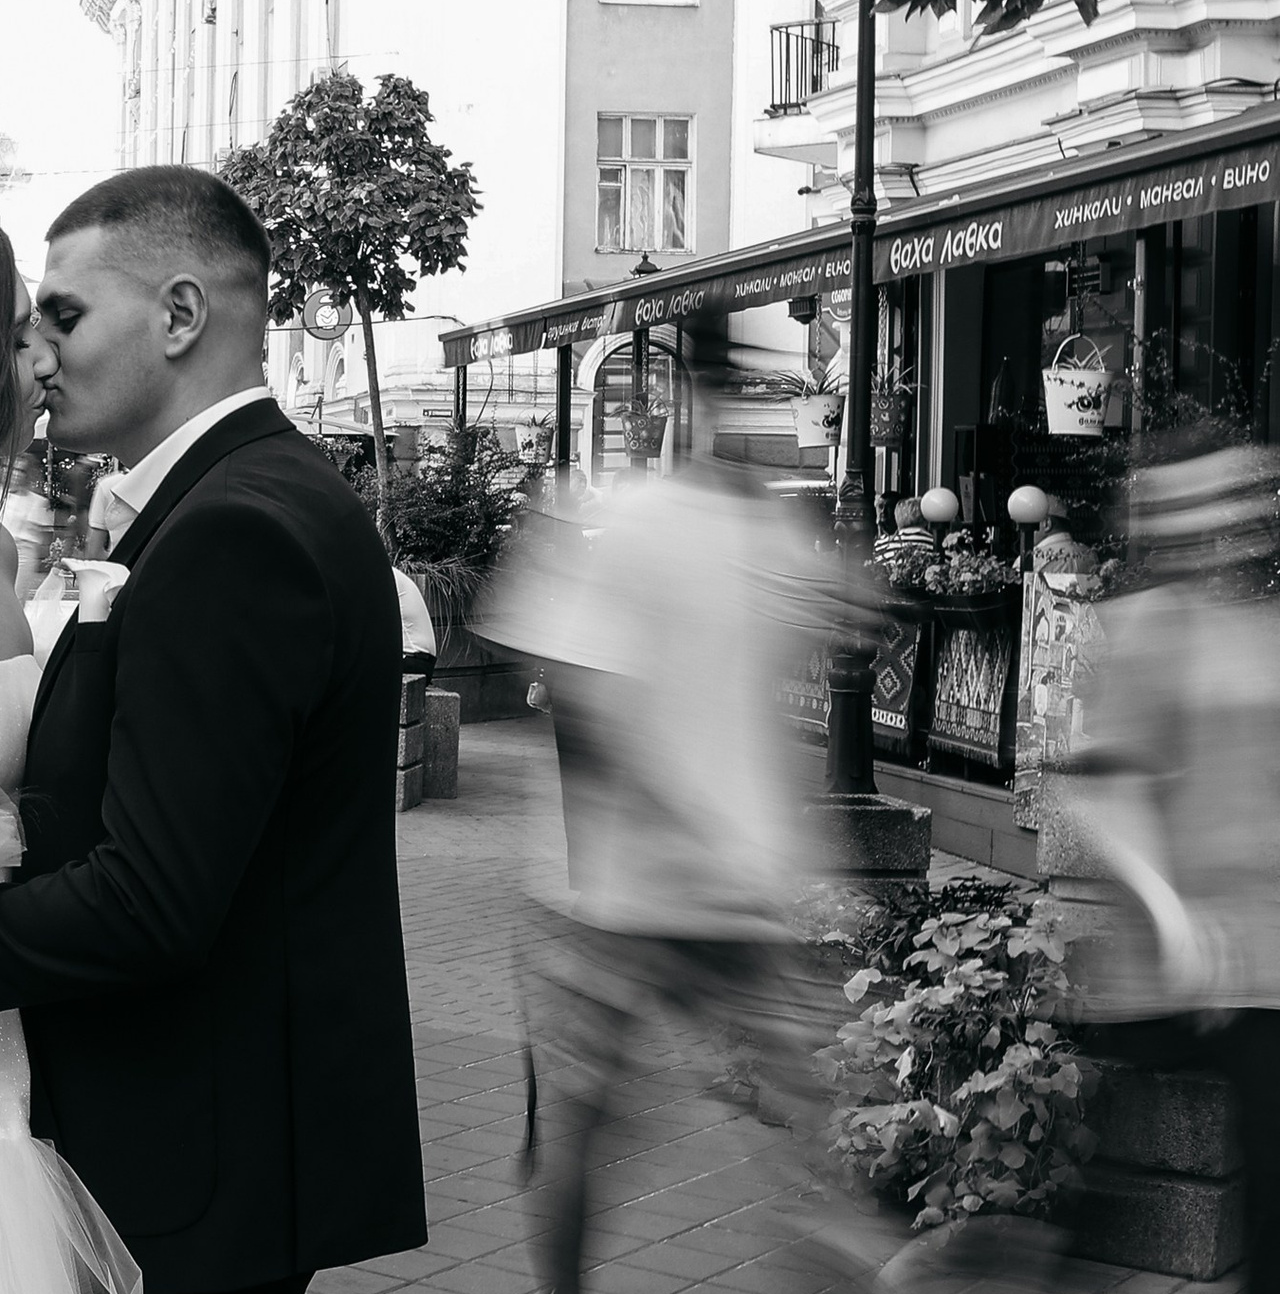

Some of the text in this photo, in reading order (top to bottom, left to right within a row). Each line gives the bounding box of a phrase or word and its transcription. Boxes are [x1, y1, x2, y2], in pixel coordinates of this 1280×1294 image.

[1055, 160, 1270, 229] хинкали мангал вино
[890, 221, 1003, 274] ваха лавка
